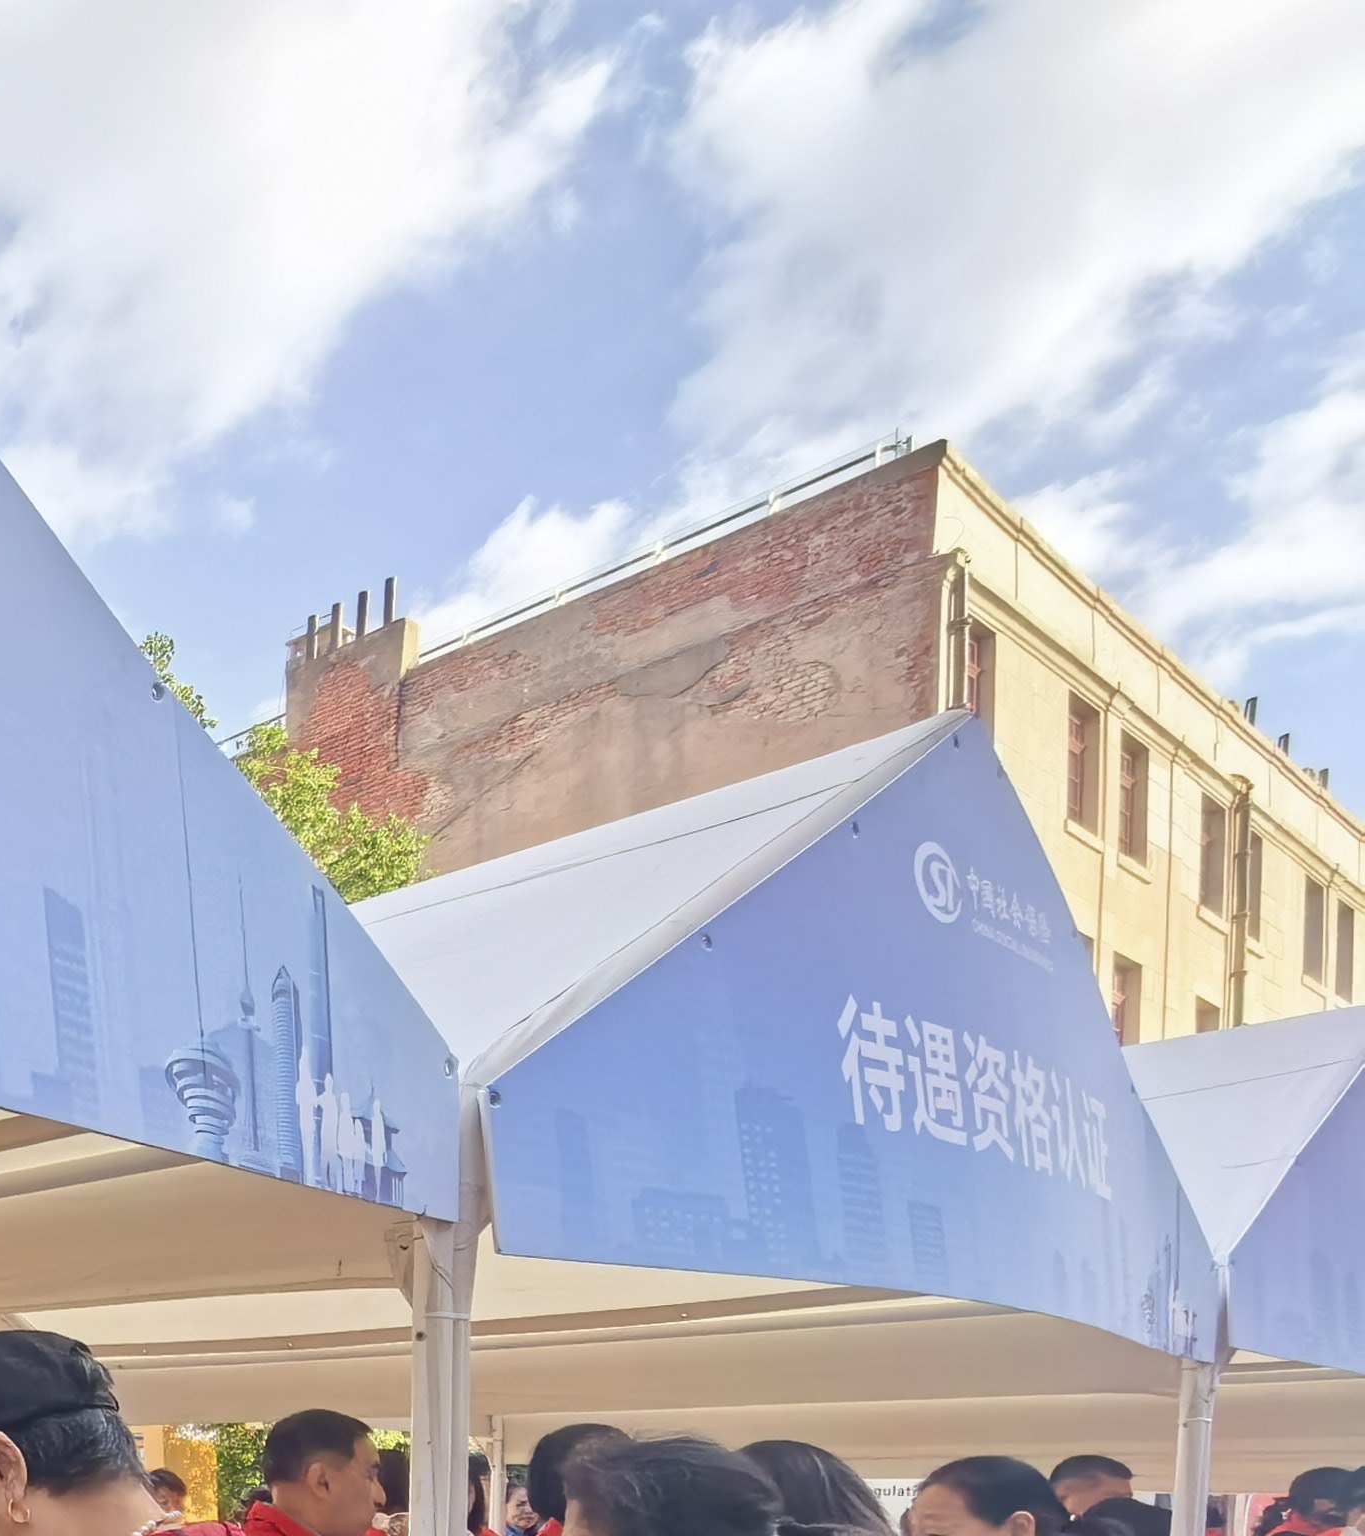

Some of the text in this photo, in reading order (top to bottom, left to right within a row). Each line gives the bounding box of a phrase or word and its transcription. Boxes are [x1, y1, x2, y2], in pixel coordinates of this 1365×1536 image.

[837, 993, 1113, 1201] 待遇资格认证
